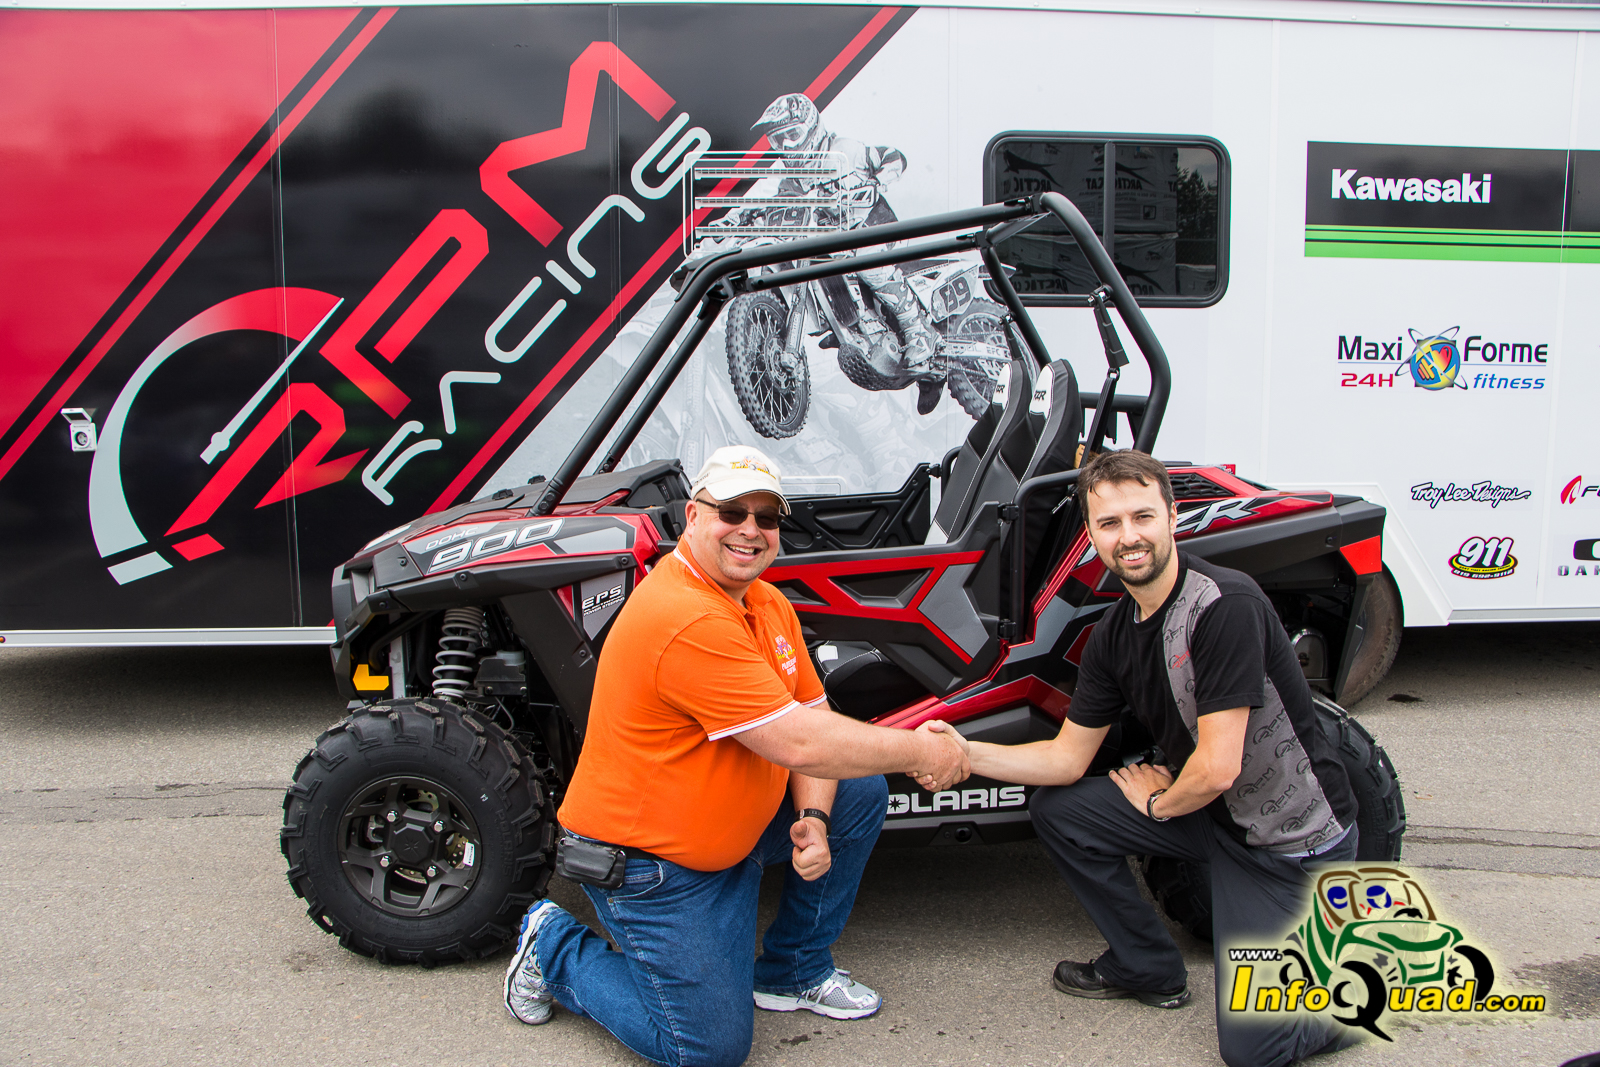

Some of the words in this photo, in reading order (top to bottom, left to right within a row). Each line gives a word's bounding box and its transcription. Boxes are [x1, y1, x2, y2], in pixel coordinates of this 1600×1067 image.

[1331, 168, 1492, 203] Kawasaki
[163, 41, 677, 537] RPM
[1337, 335, 1403, 361] Maxi
[1463, 335, 1548, 363] Forme
[1341, 373, 1394, 388] 24H
[1473, 373, 1545, 389] fitness
[1411, 481, 1444, 509] Troy
[1443, 483, 1473, 502] Lee
[1176, 497, 1256, 534] ZR
[425, 526, 480, 551] DOHC
[427, 517, 565, 575] 900
[1457, 536, 1514, 567] 911
[581, 584, 622, 610] EPS
[886, 785, 1026, 815] OLARIS
